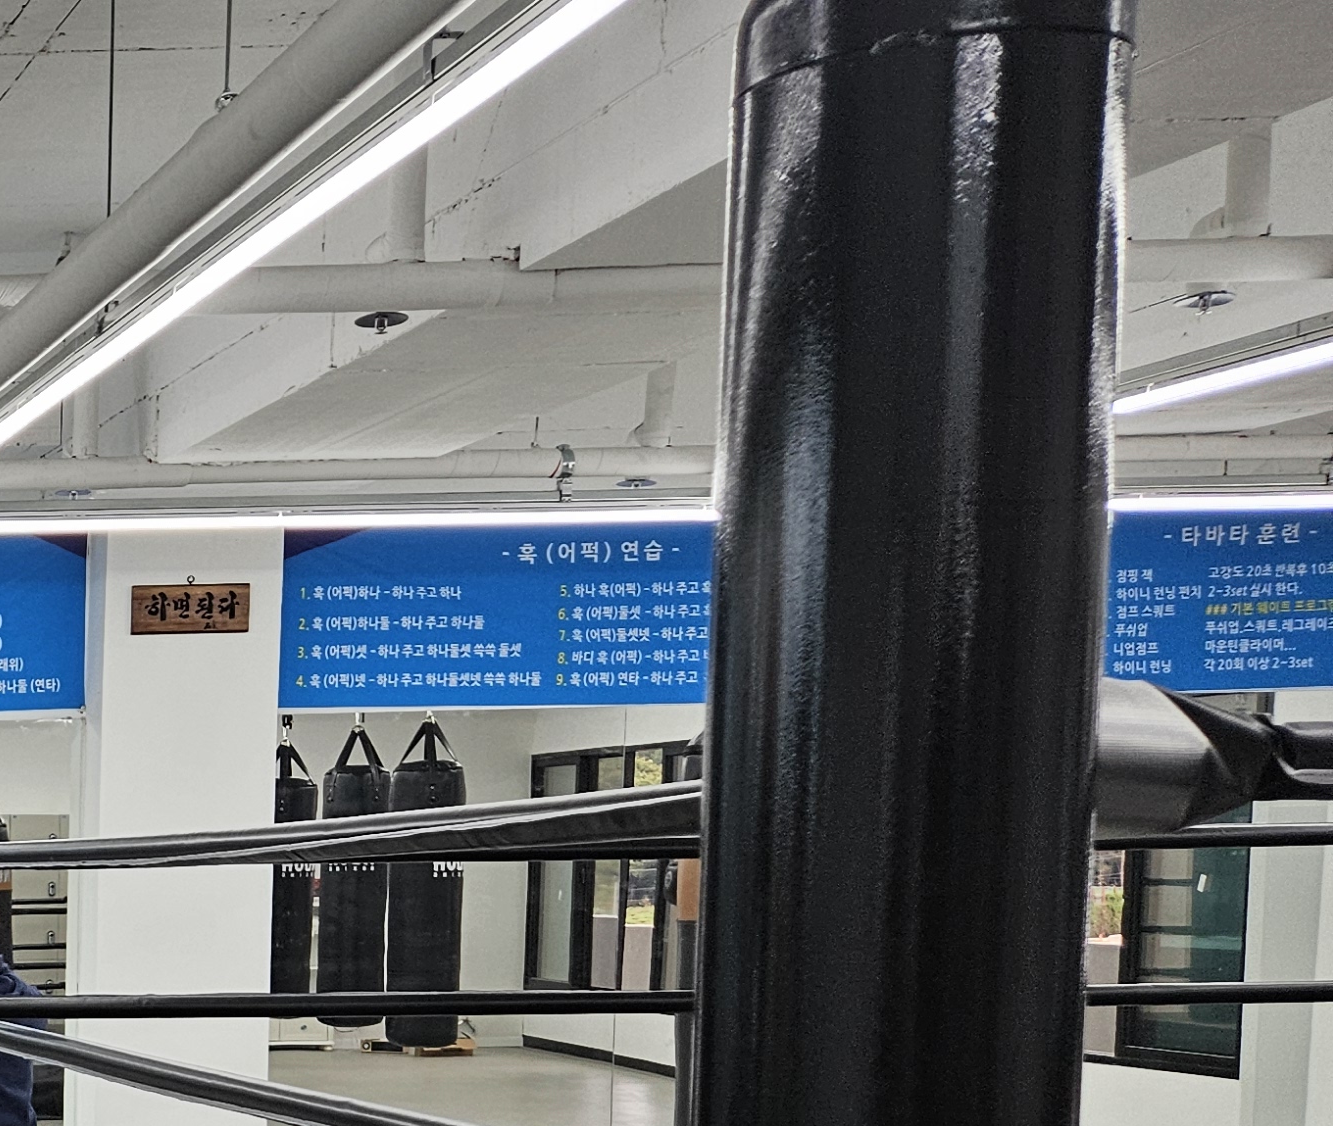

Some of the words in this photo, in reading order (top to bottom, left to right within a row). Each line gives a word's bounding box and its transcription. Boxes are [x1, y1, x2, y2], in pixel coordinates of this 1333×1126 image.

[1182, 525, 1249, 546] 타바타
[518, 543, 537, 564] 훅
[621, 540, 663, 561] 연습
[439, 586, 462, 600] 하나
